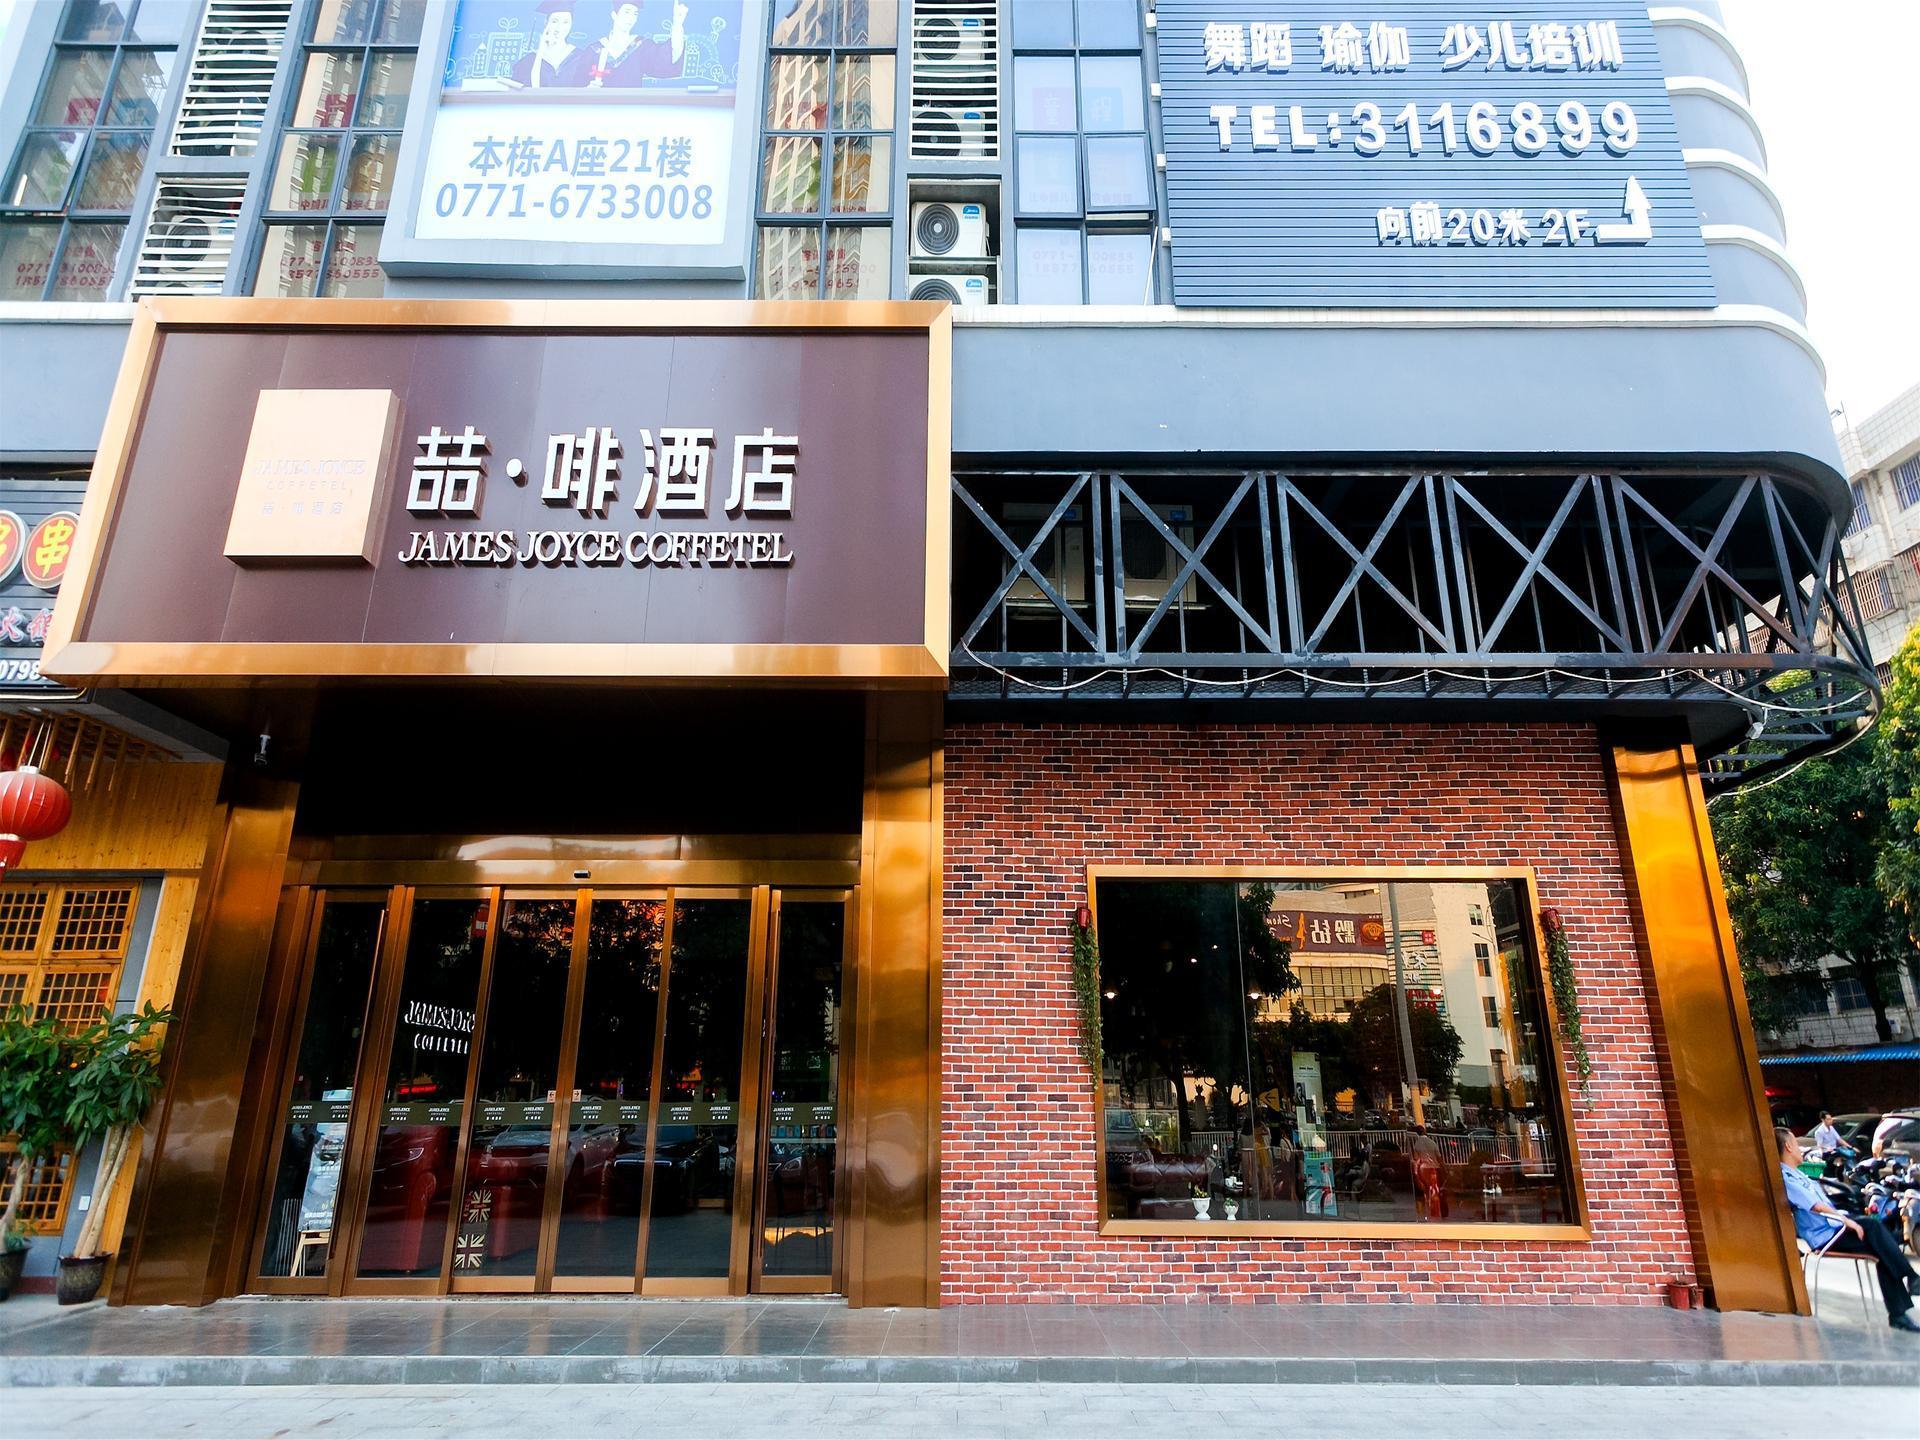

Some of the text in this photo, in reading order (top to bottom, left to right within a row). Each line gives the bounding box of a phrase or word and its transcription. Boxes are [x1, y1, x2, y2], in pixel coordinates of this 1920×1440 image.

[1204, 21, 1624, 71] 舞蹈 瑜伽 少儿培训
[469, 136, 692, 178] 本栋A座21楼
[435, 183, 713, 220] 0771-6733008
[398, 531, 794, 569] JAMES JOYCE COFFETEL
